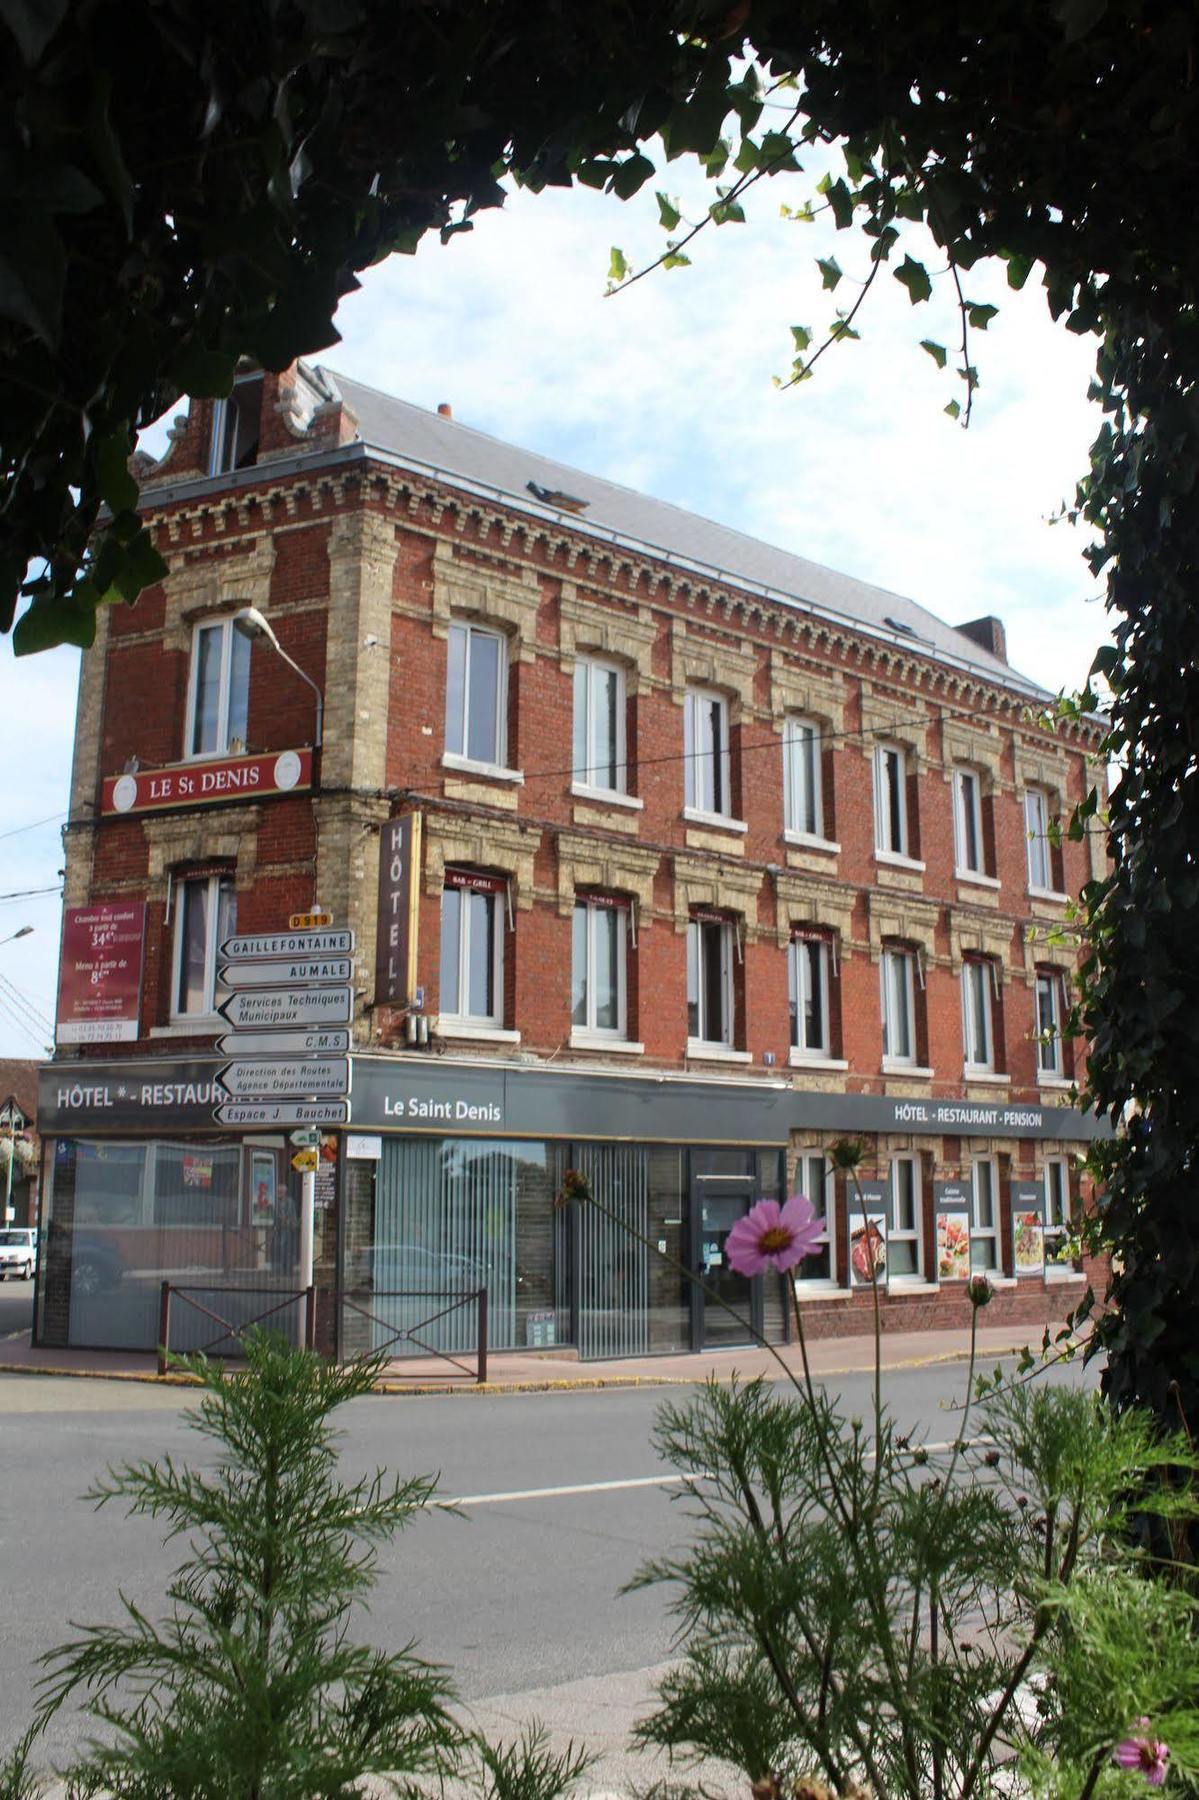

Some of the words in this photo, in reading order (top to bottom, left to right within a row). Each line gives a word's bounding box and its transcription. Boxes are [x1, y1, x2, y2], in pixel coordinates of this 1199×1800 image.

[150, 778, 172, 799] LE
[178, 776, 194, 794] St
[202, 766, 260, 792] DENIS
[388, 826, 403, 980] HÔTEL
[233, 936, 346, 954] GAILLEFONTAINE
[289, 964, 346, 978] AUMALE
[239, 996, 282, 1009] Services
[289, 994, 345, 1007] Techniques
[239, 1010, 298, 1023] Municipaux
[236, 1067, 277, 1077] Direction
[281, 1067, 296, 1076] des
[301, 1066, 331, 1076] Routes
[236, 1080, 268, 1092] Agence
[57, 1083, 113, 1108] HÔTEL
[227, 1108, 266, 1121] Espace
[296, 1107, 343, 1119] Bauchet
[384, 1096, 405, 1116] Le
[408, 1097, 452, 1119] Saint
[455, 1101, 501, 1121] Denis
[894, 1103, 928, 1121] HÔTEL
[937, 1108, 997, 1125] RESTAURANT
[1004, 1111, 1042, 1127] PENSION
